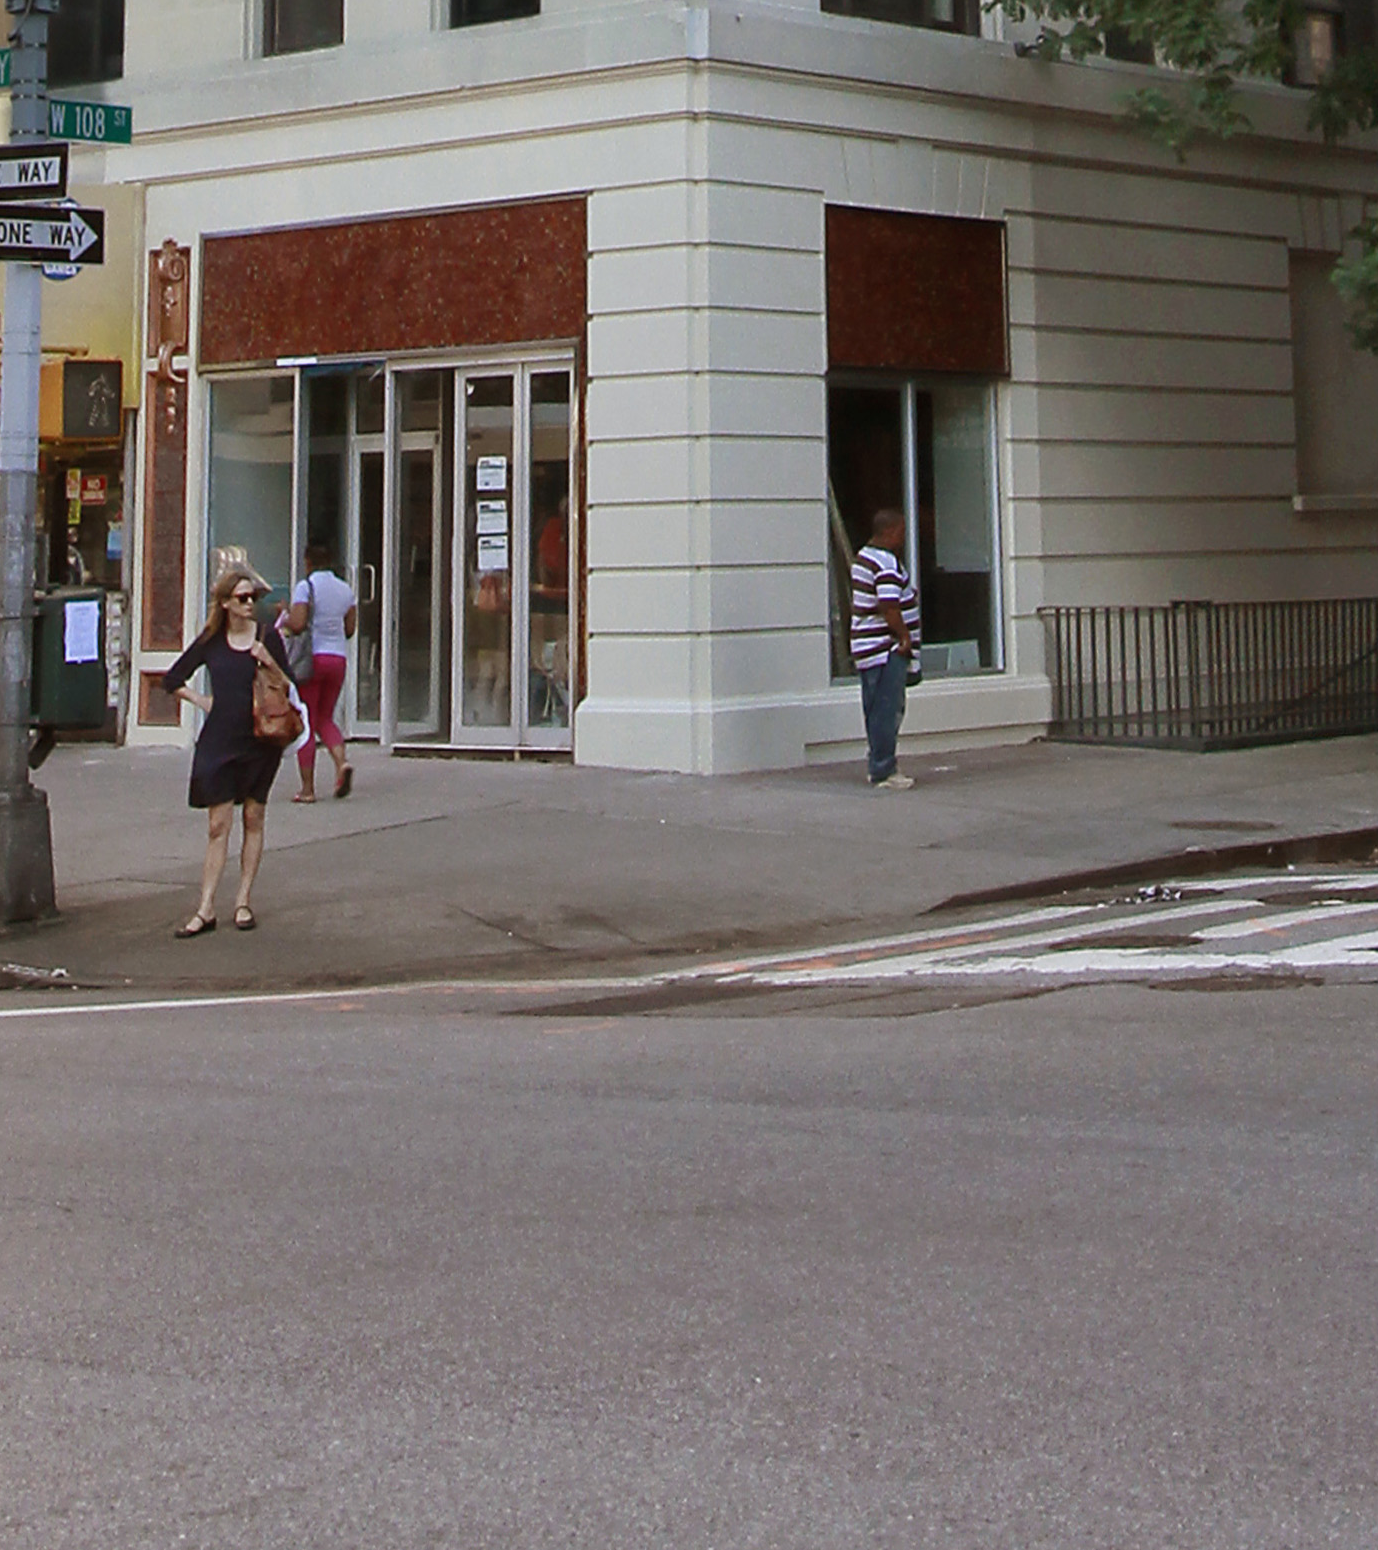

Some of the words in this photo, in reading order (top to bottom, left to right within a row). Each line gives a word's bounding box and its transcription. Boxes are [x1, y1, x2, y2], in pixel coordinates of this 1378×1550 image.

[51, 103, 65, 134] W
[75, 106, 105, 139] 108
[114, 110, 126, 127] ST
[18, 160, 52, 183] WAY
[49, 224, 86, 247] WAY
